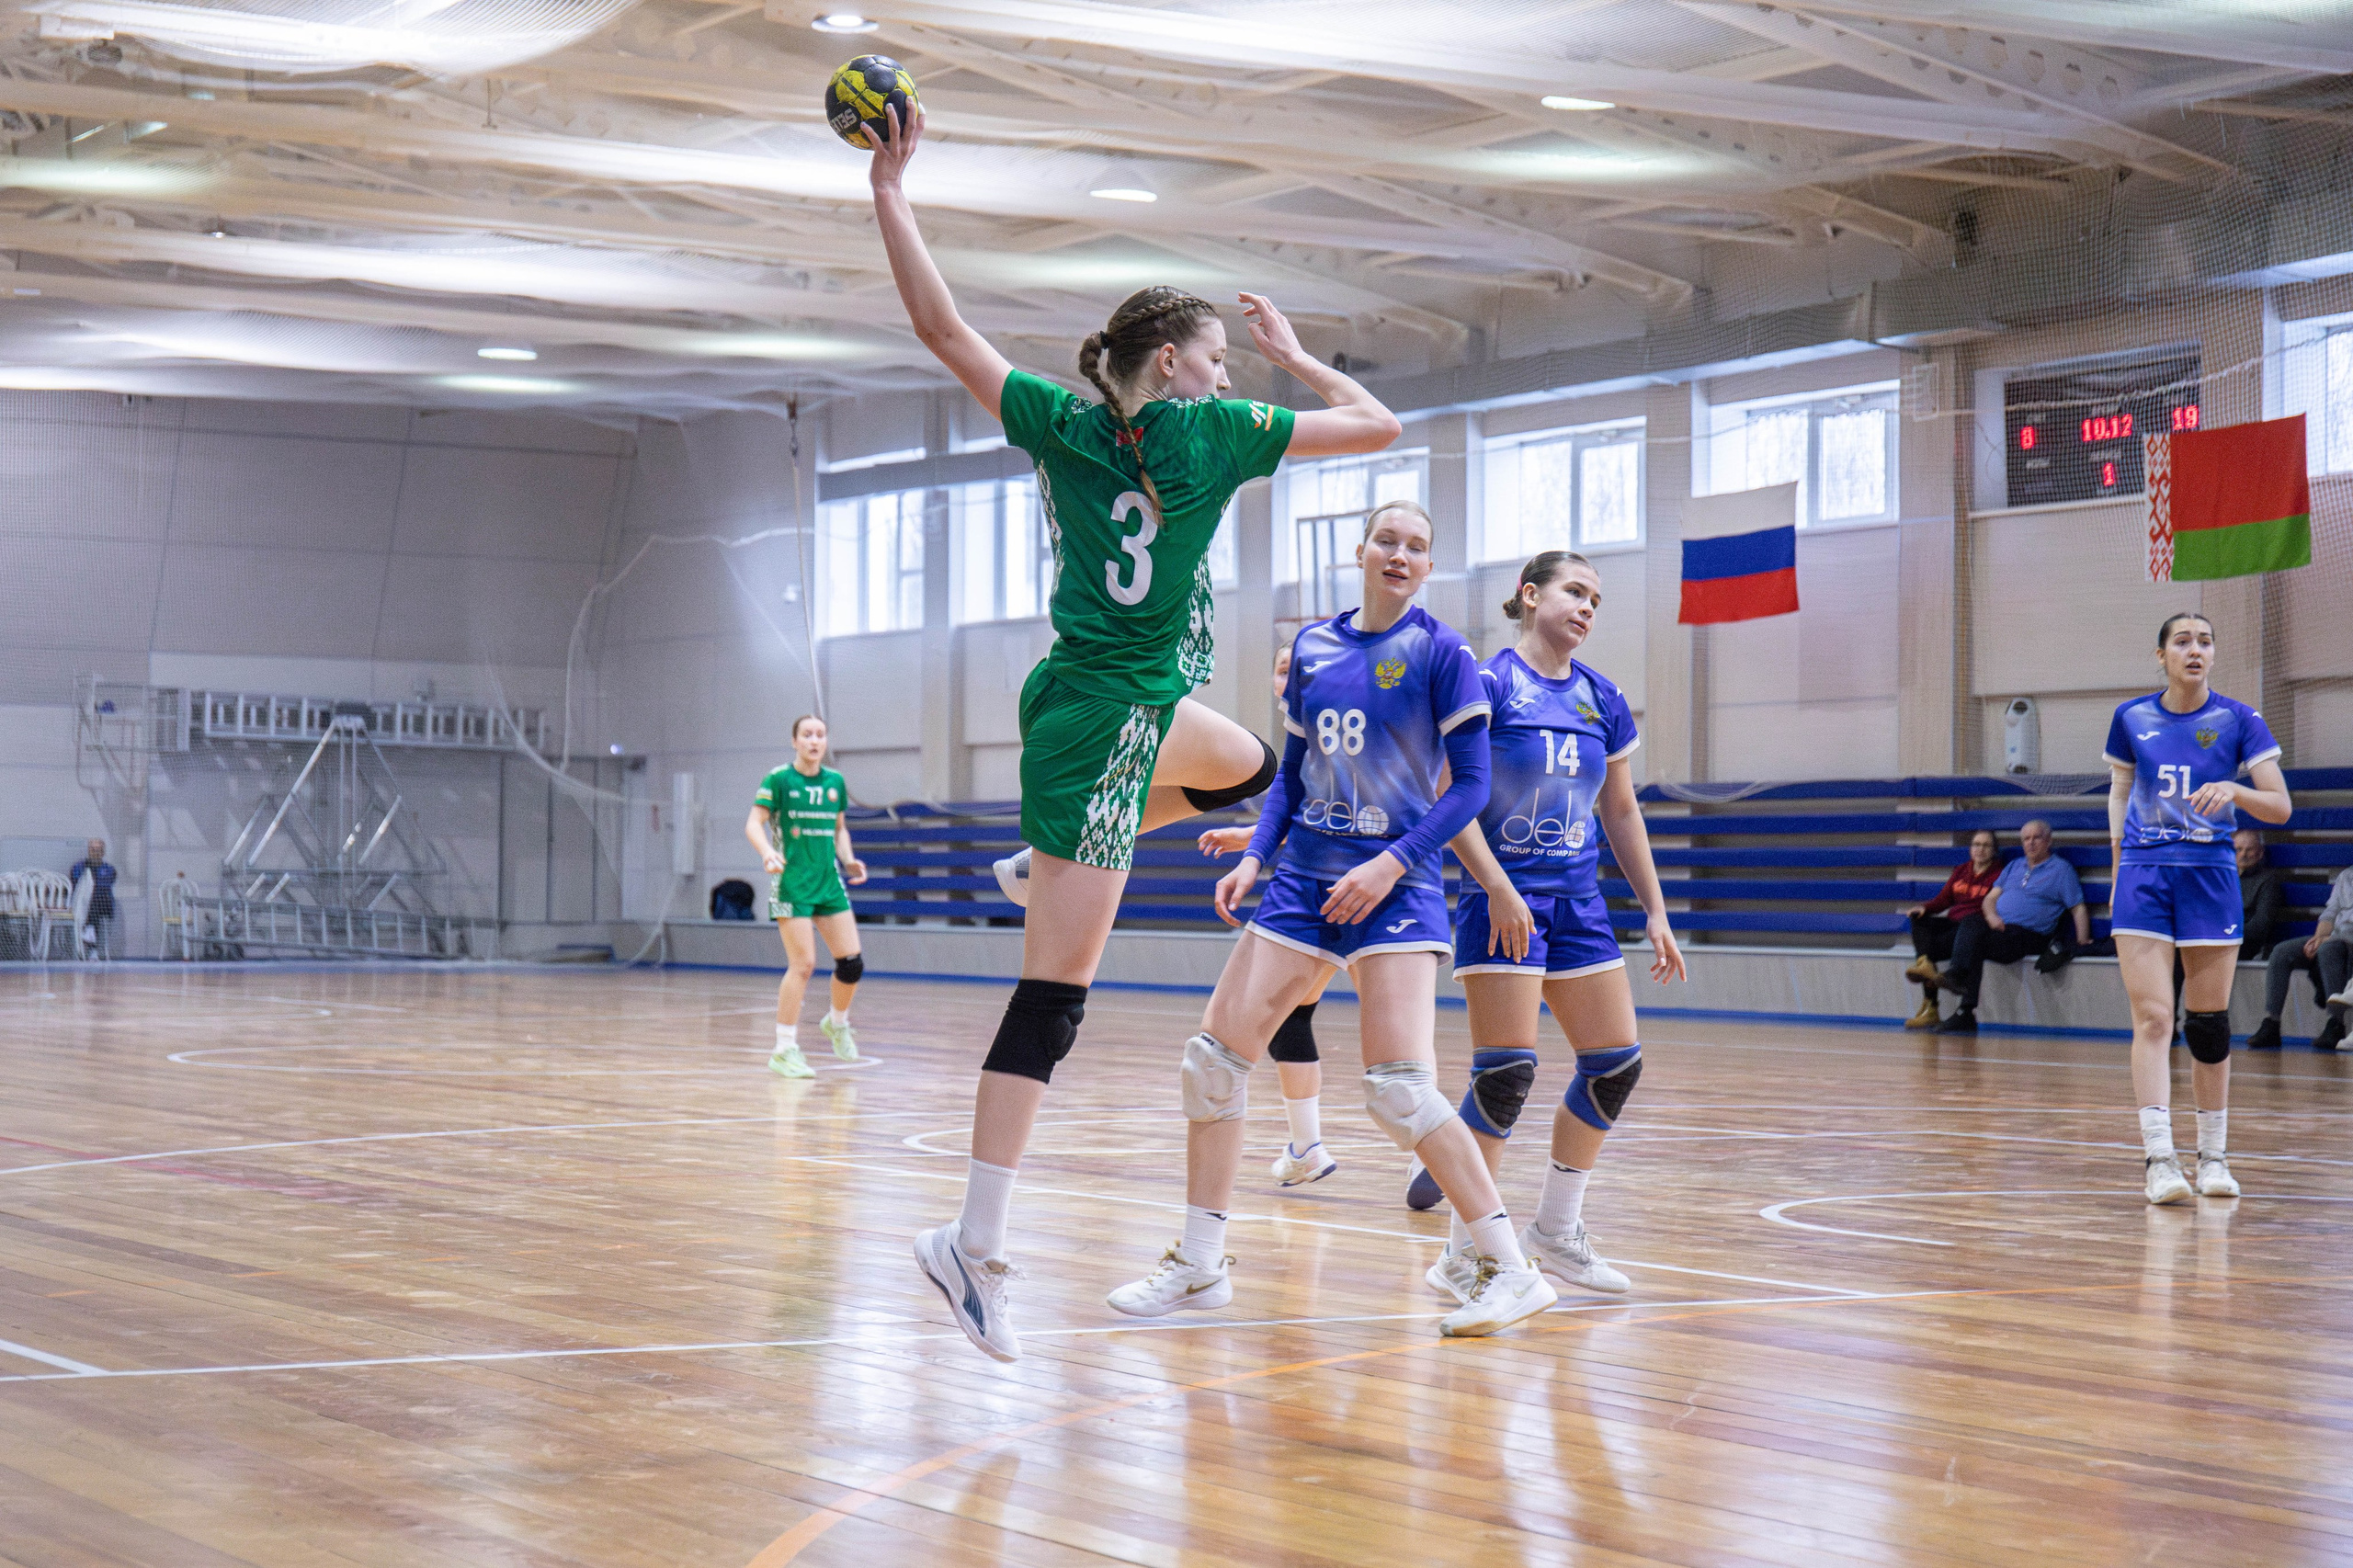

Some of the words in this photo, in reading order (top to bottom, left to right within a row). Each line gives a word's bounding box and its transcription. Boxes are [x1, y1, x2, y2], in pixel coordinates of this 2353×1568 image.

[2172, 404, 2199, 430] 19
[2103, 462, 2115, 487] 1
[1105, 491, 1158, 607] 3
[1316, 708, 1367, 756] 88
[1540, 729, 1580, 776] 14
[804, 785, 824, 805] 77
[2157, 764, 2191, 800] 51
[1499, 844, 1531, 855] GROUP
[1532, 847, 1545, 856] OF
